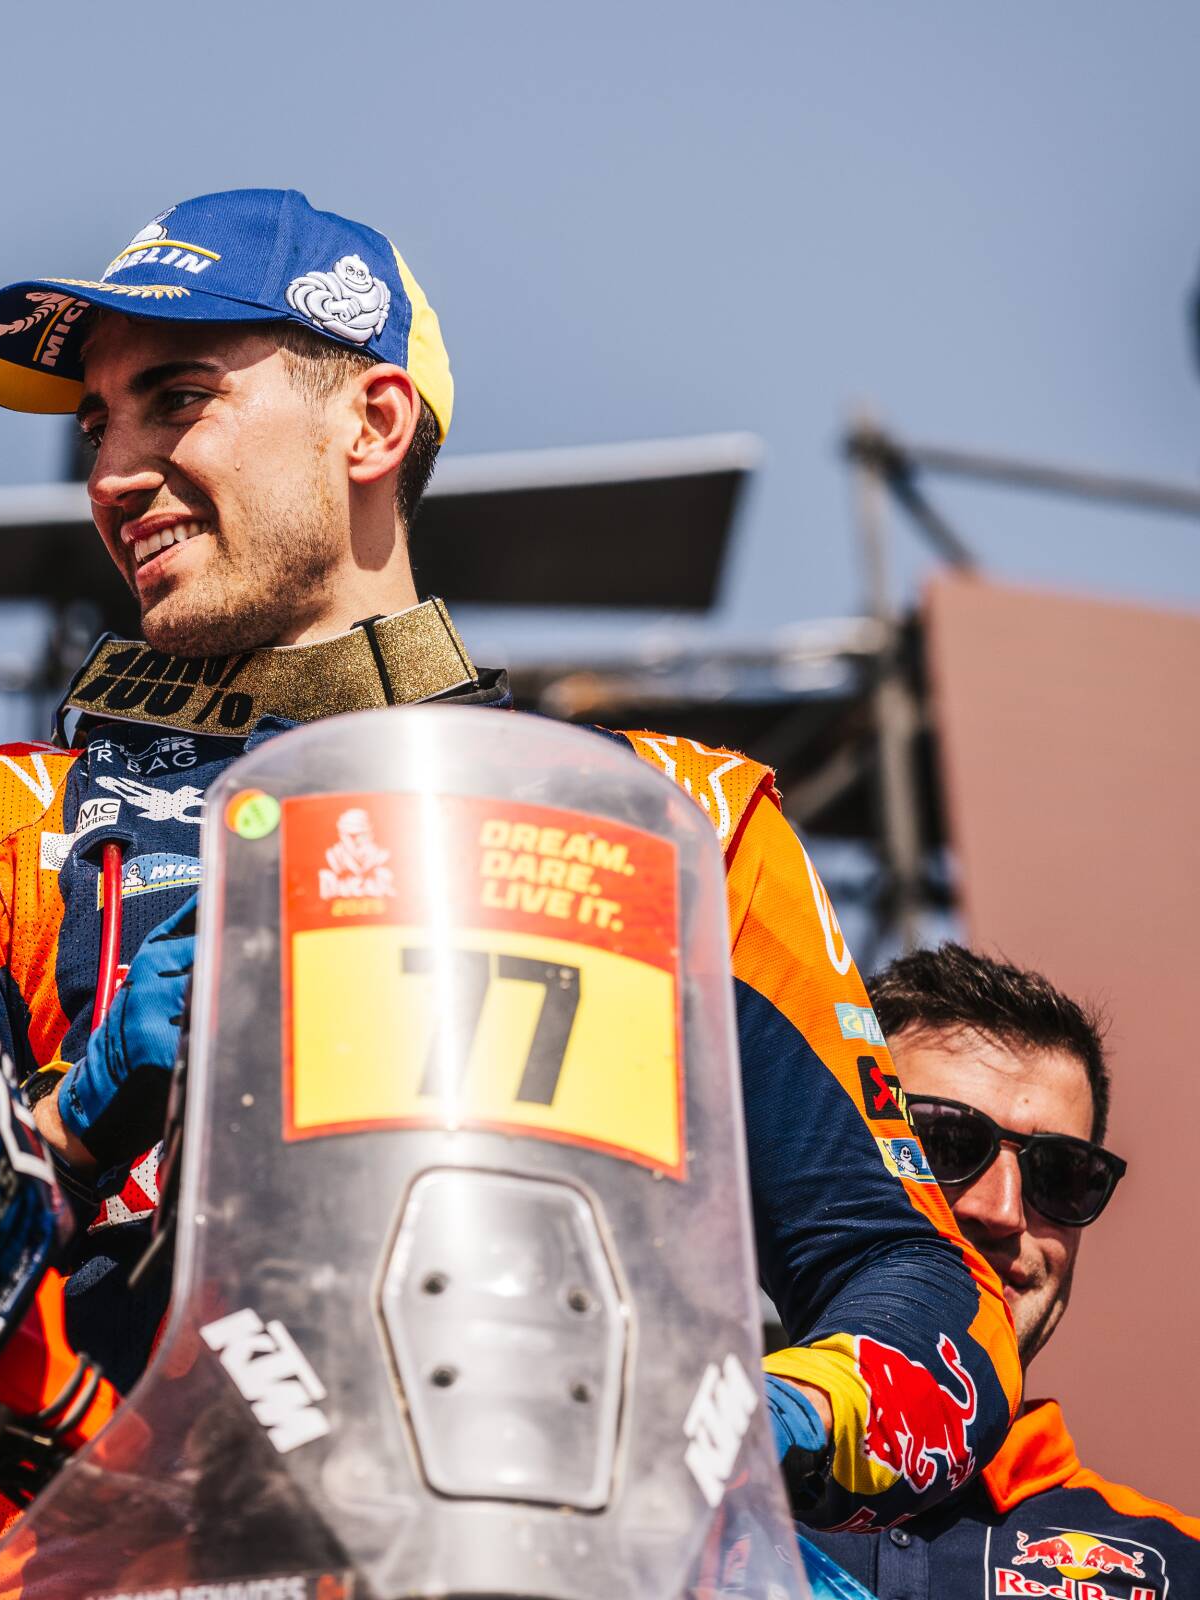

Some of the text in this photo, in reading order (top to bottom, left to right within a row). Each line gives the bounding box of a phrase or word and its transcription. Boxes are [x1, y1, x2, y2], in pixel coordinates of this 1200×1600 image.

[480, 819, 636, 877] DREAM.
[480, 849, 603, 896] DARE.
[481, 879, 624, 933] LIVE IT.
[401, 946, 581, 1108] 77
[200, 1308, 331, 1454] KTM
[995, 1568, 1075, 1600] Red
